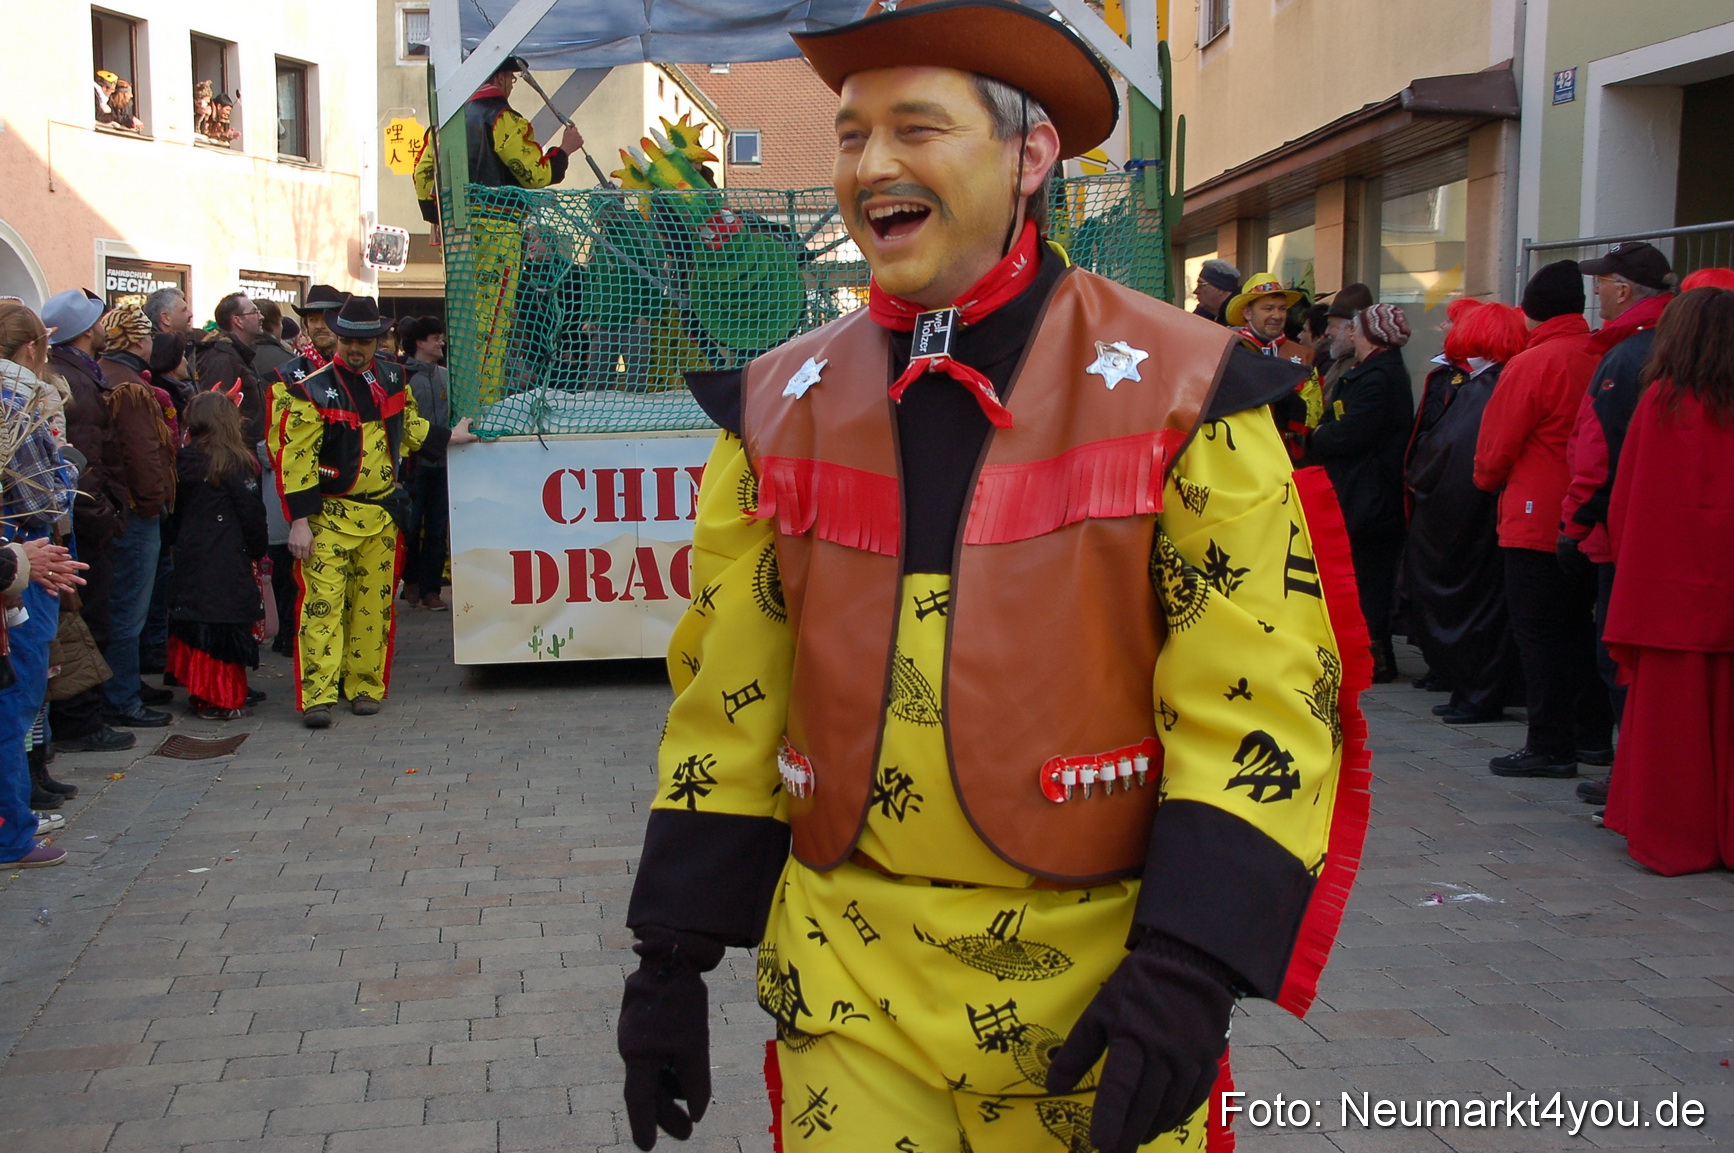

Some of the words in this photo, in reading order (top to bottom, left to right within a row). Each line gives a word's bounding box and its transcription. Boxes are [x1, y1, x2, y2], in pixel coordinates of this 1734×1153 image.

[1556, 71, 1572, 89] 42
[107, 269, 152, 280] FAHRSCHULE
[919, 320, 935, 352] holzer
